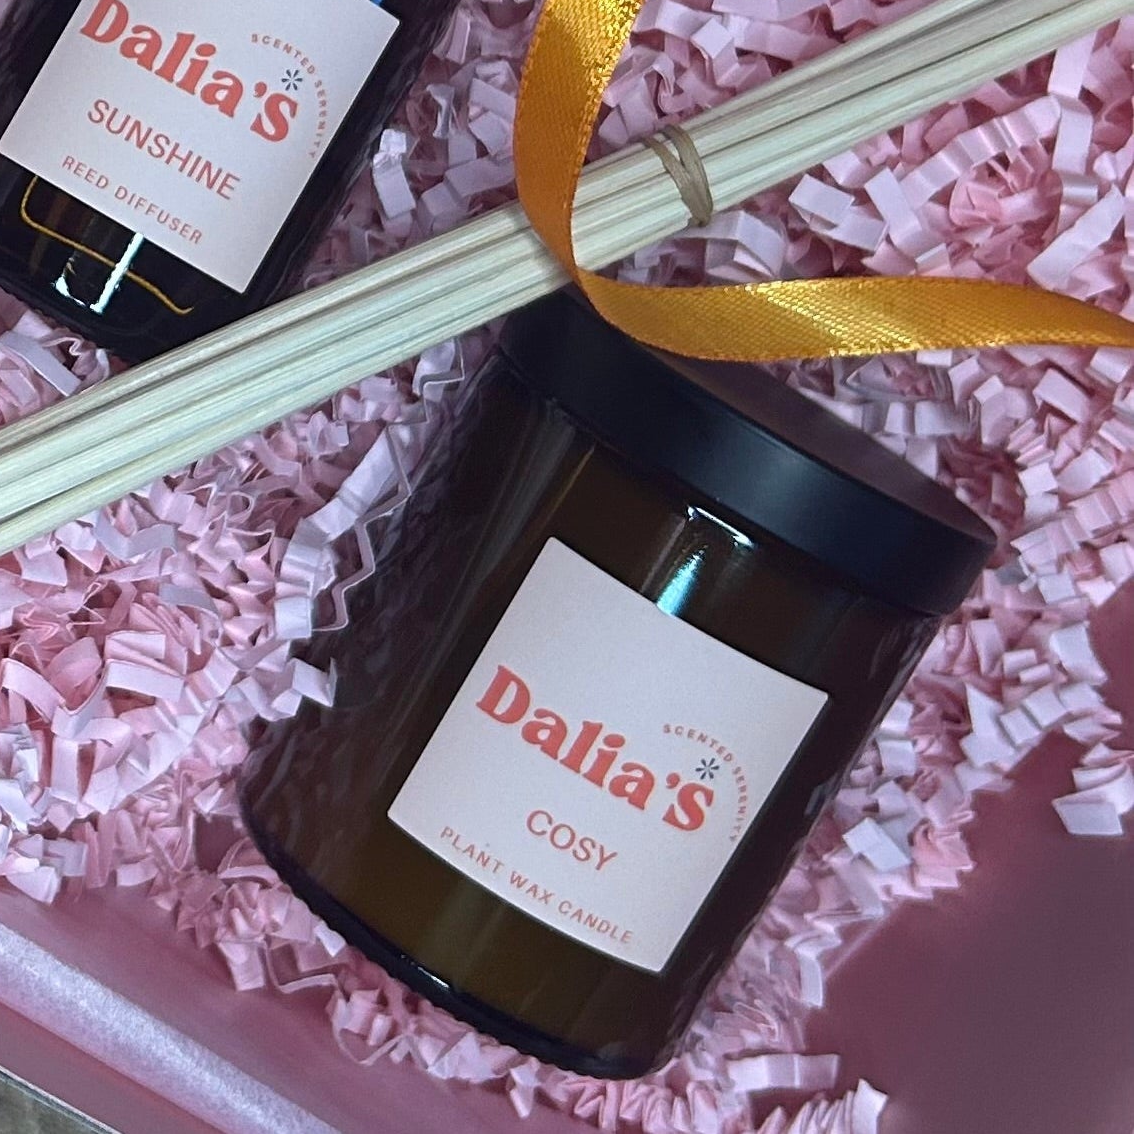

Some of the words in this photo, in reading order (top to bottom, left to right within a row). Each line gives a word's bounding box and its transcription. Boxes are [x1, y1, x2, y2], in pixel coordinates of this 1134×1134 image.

[87, 99, 241, 200] SUNSHINE
[251, 33, 316, 75] SCENTED
[307, 79, 329, 159] SERENITY
[62, 155, 109, 190] REED
[114, 185, 204, 245] DIFFUSER
[663, 723, 734, 763] SCENTED
[729, 766, 750, 843] SERENITY
[440, 826, 505, 875] PLANT
[509, 870, 553, 906] WAX
[557, 899, 636, 945] CANDLE
[526, 809, 618, 872] COSY
